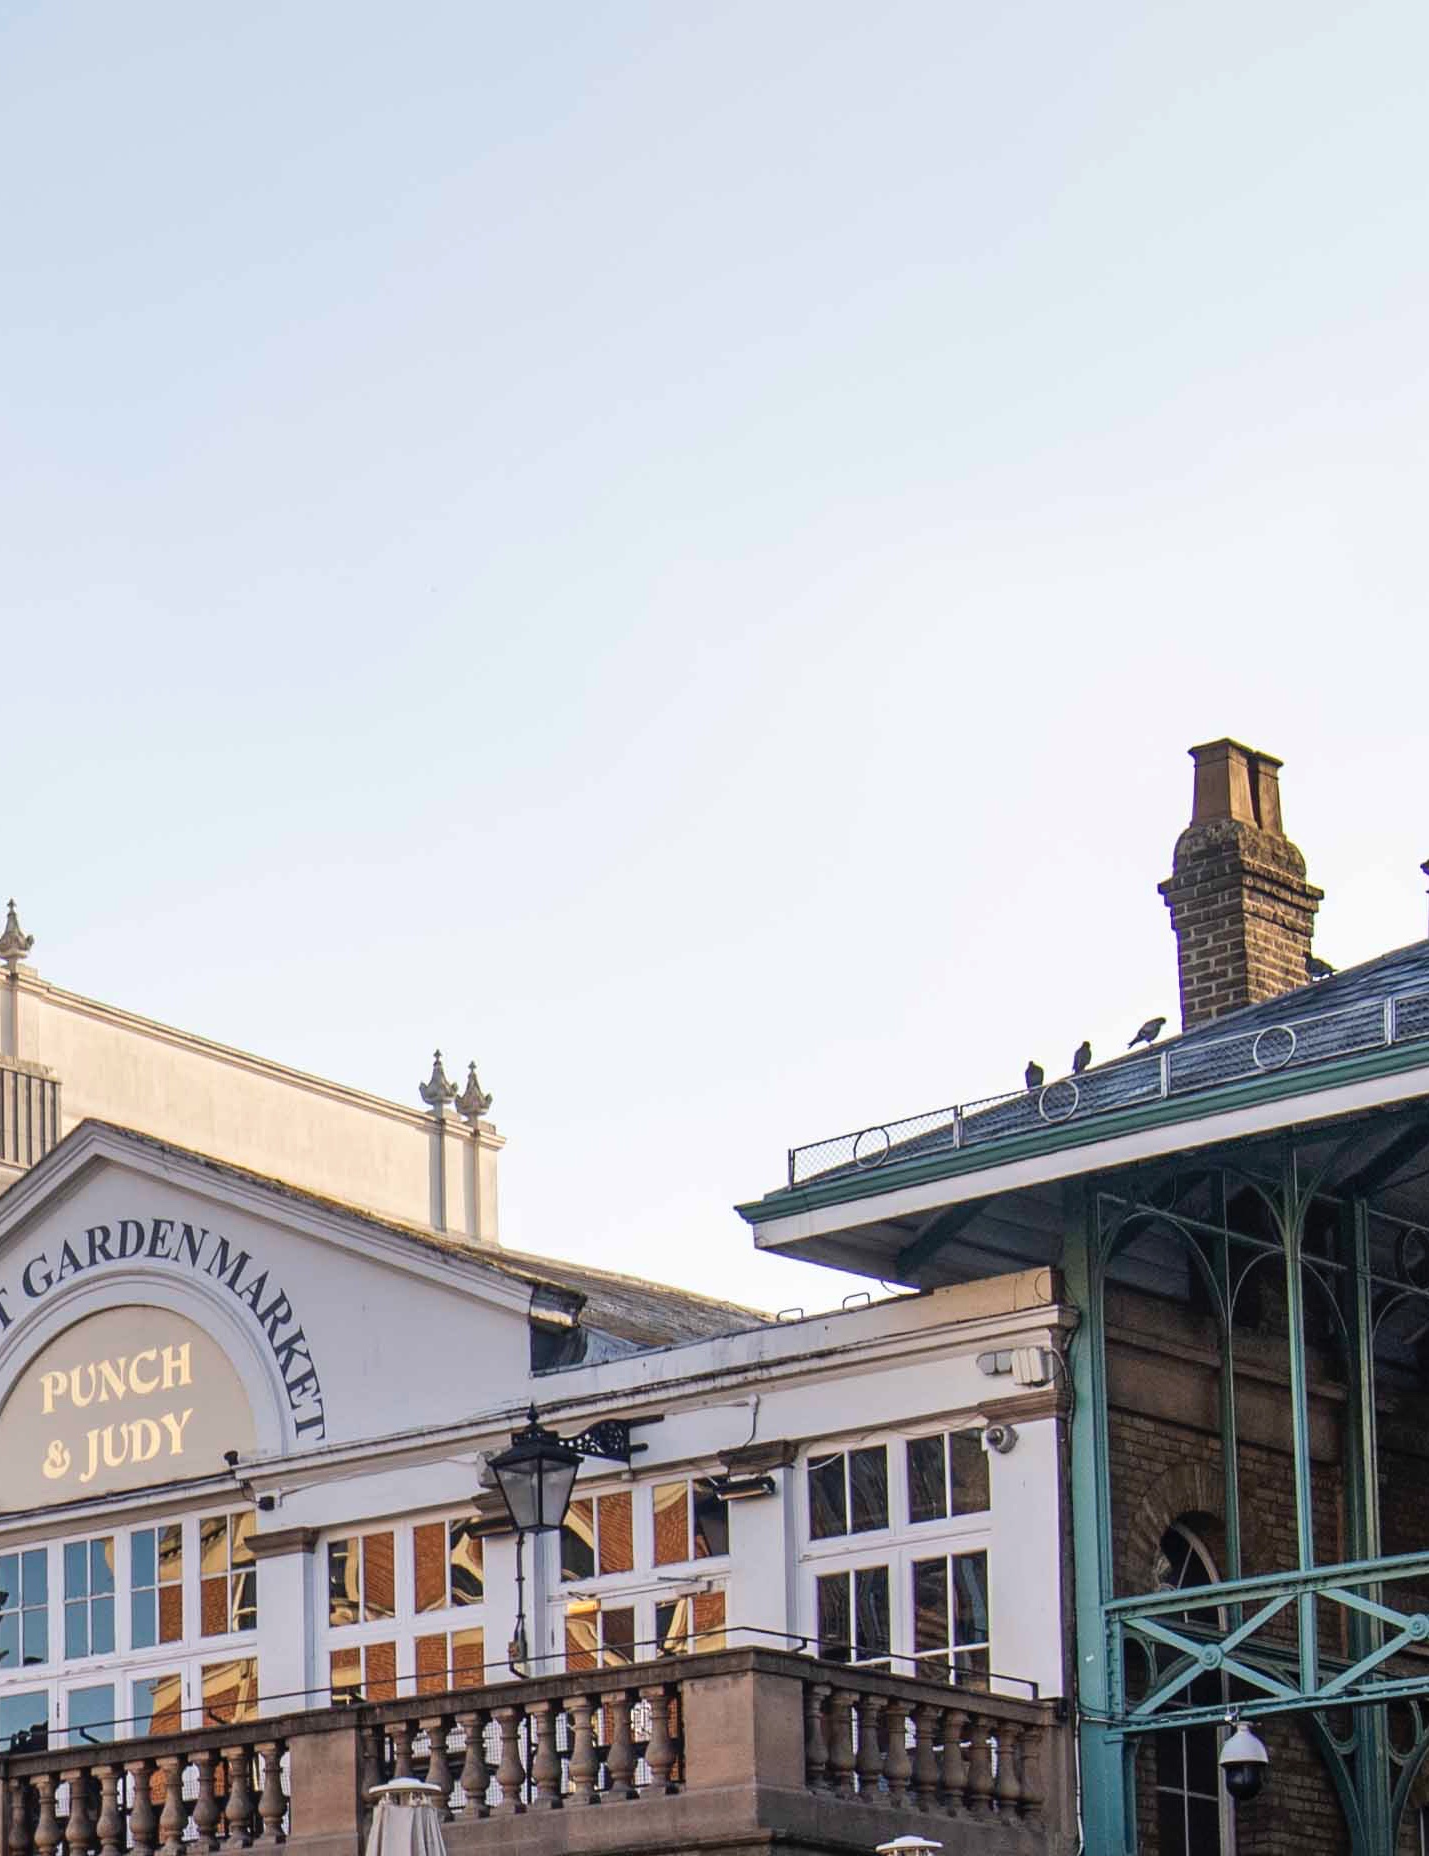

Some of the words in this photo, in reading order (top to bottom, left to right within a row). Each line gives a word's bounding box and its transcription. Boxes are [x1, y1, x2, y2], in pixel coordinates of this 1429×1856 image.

[21, 1218, 209, 1298] GARDEN
[203, 1237, 326, 1441] MARKET
[40, 1341, 193, 1415] PUNCH
[43, 1439, 71, 1479] &
[79, 1408, 194, 1483] JUDY
